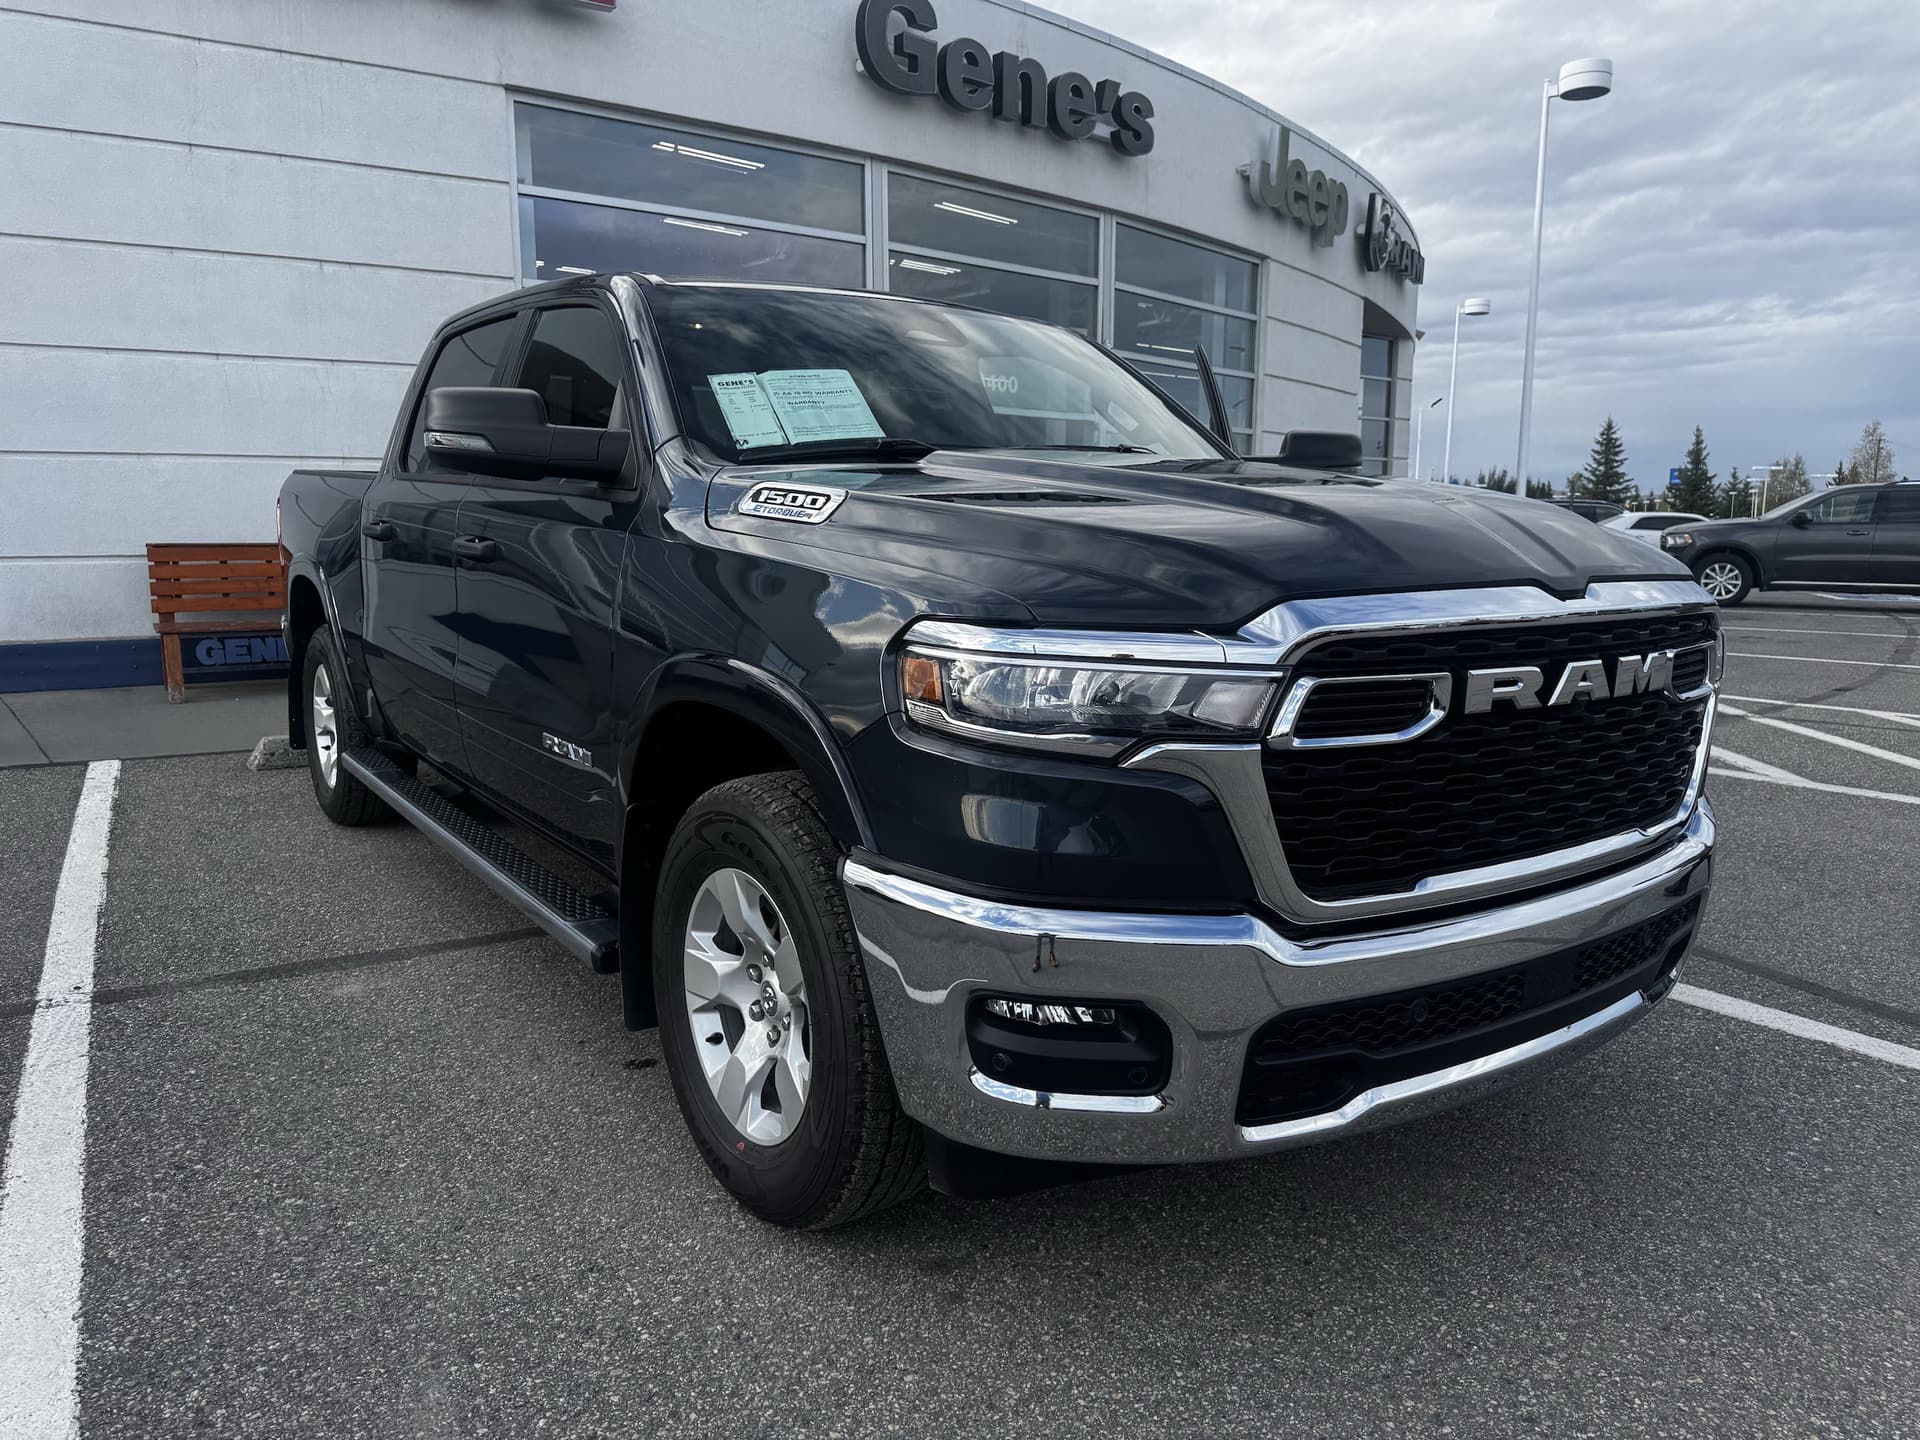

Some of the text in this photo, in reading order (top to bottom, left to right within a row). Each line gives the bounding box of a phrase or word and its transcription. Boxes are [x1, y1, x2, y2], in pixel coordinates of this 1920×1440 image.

[855, 0, 1155, 157] Gene's
[1250, 125, 1349, 249] Jeep
[717, 378, 755, 387] GENE'S
[758, 489, 828, 509] 1500
[1464, 652, 1668, 714] RAM
